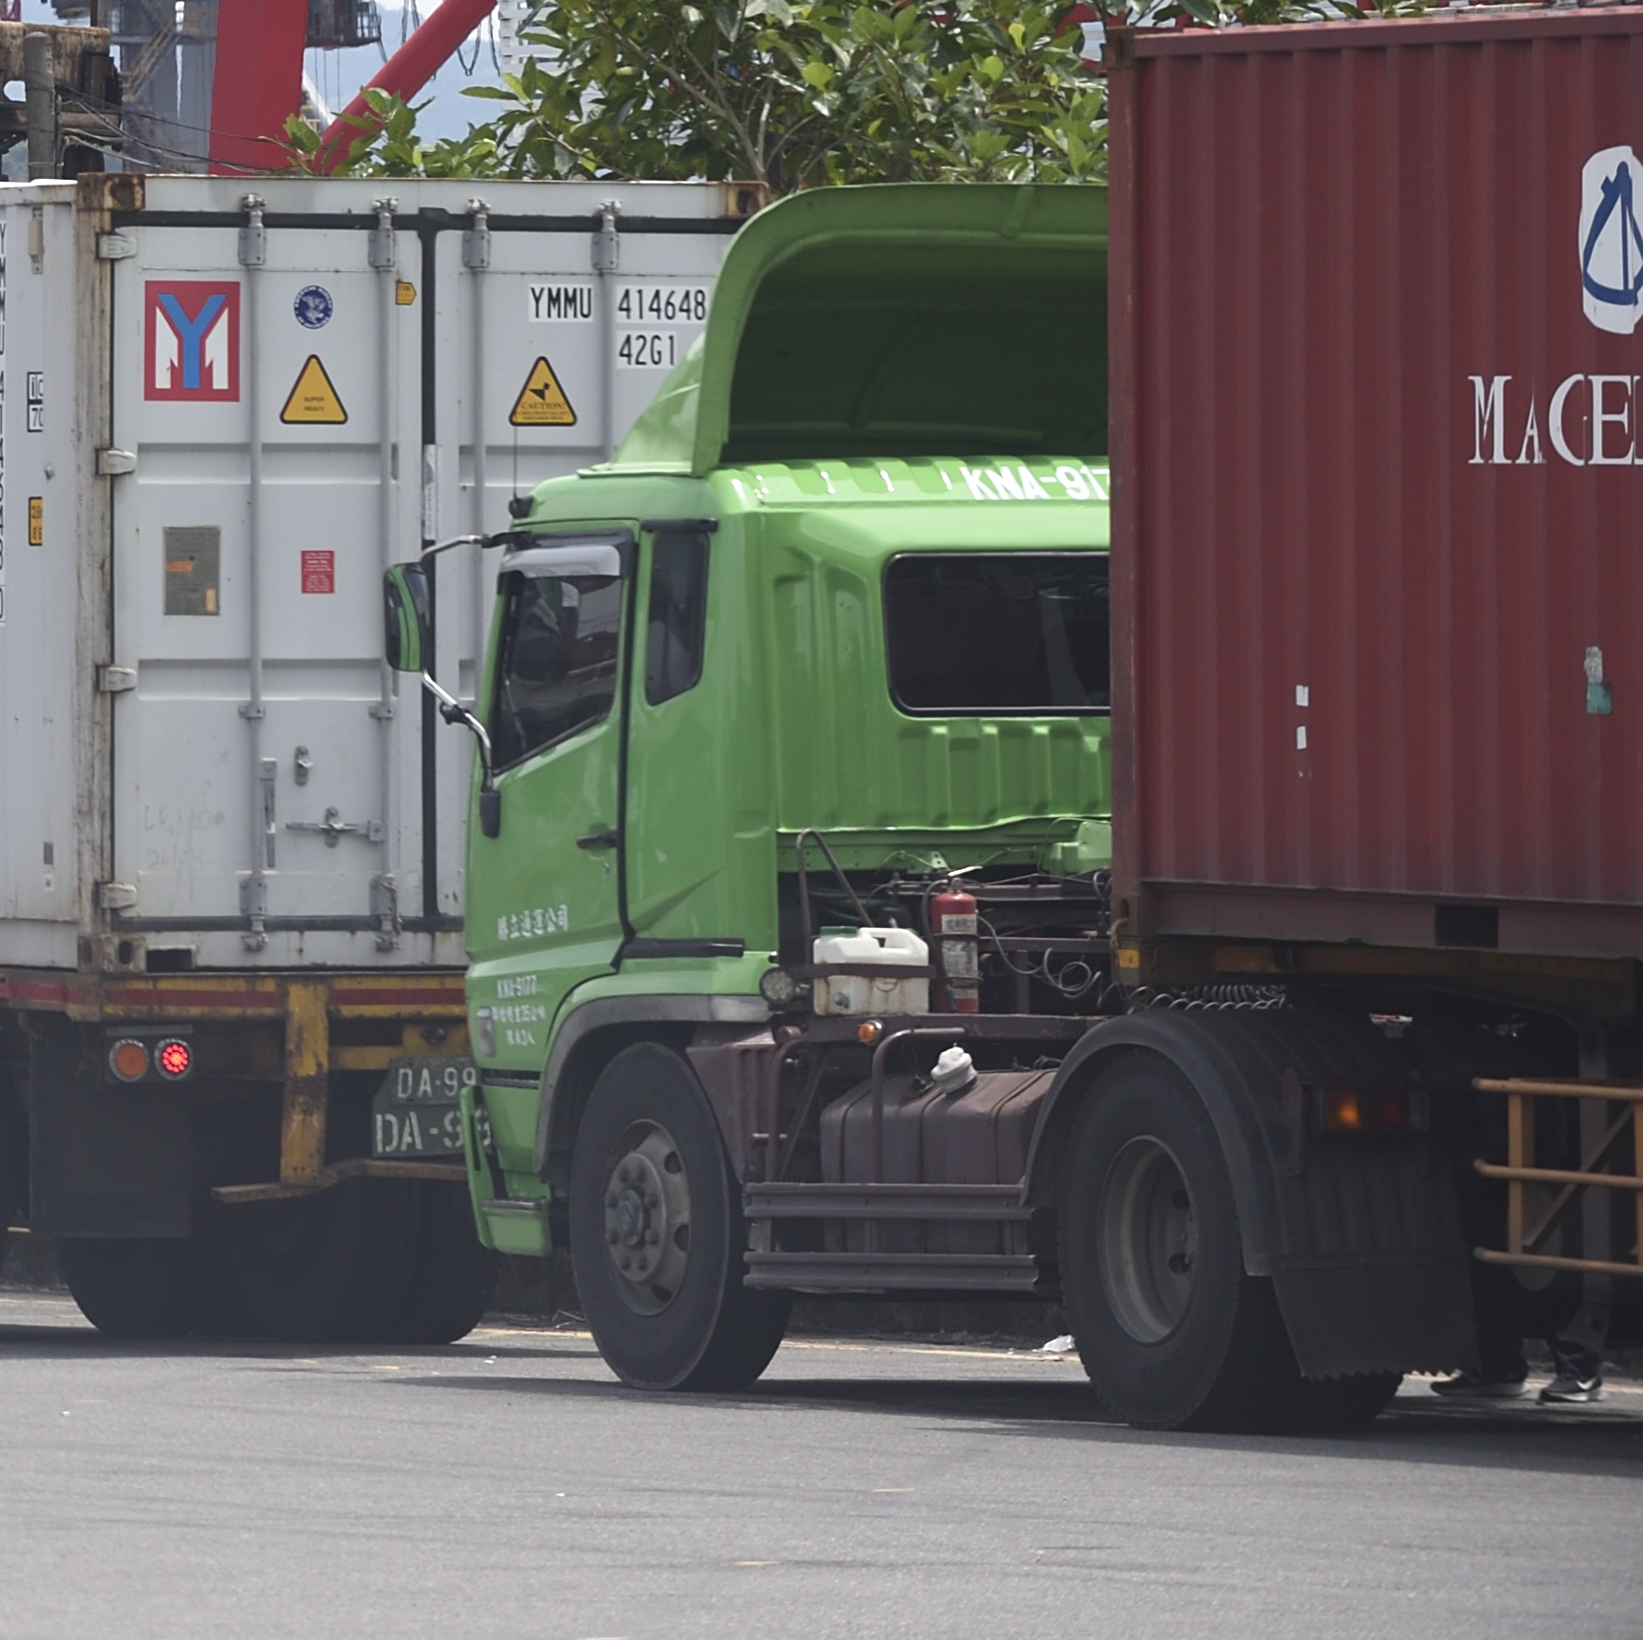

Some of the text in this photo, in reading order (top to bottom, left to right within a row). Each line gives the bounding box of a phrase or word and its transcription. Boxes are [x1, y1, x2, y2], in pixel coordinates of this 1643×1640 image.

[530, 287, 707, 321] YMMU 414648
[619, 334, 675, 366] 42G1
